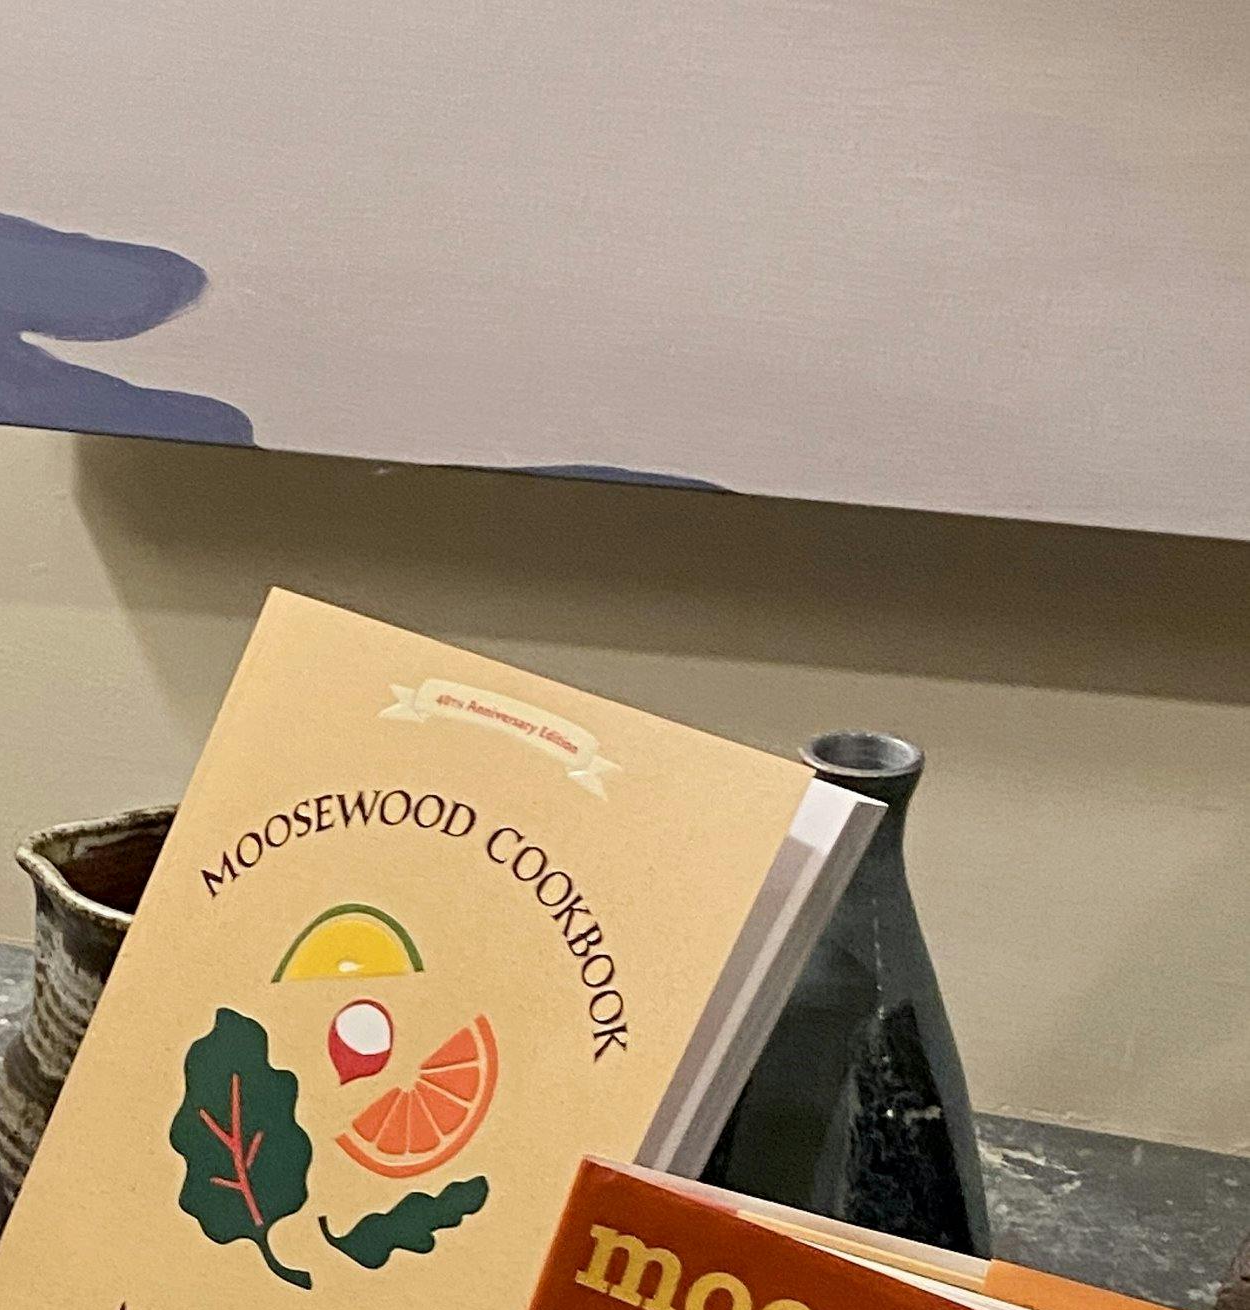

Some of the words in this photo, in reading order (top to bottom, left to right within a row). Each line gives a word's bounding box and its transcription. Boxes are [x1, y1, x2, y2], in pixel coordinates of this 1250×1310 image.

[466, 700, 538, 735] Anniversary
[539, 726, 579, 755] Edition
[200, 788, 478, 898] MOOSEWOOD
[485, 826, 629, 1064] COOKBOOK
